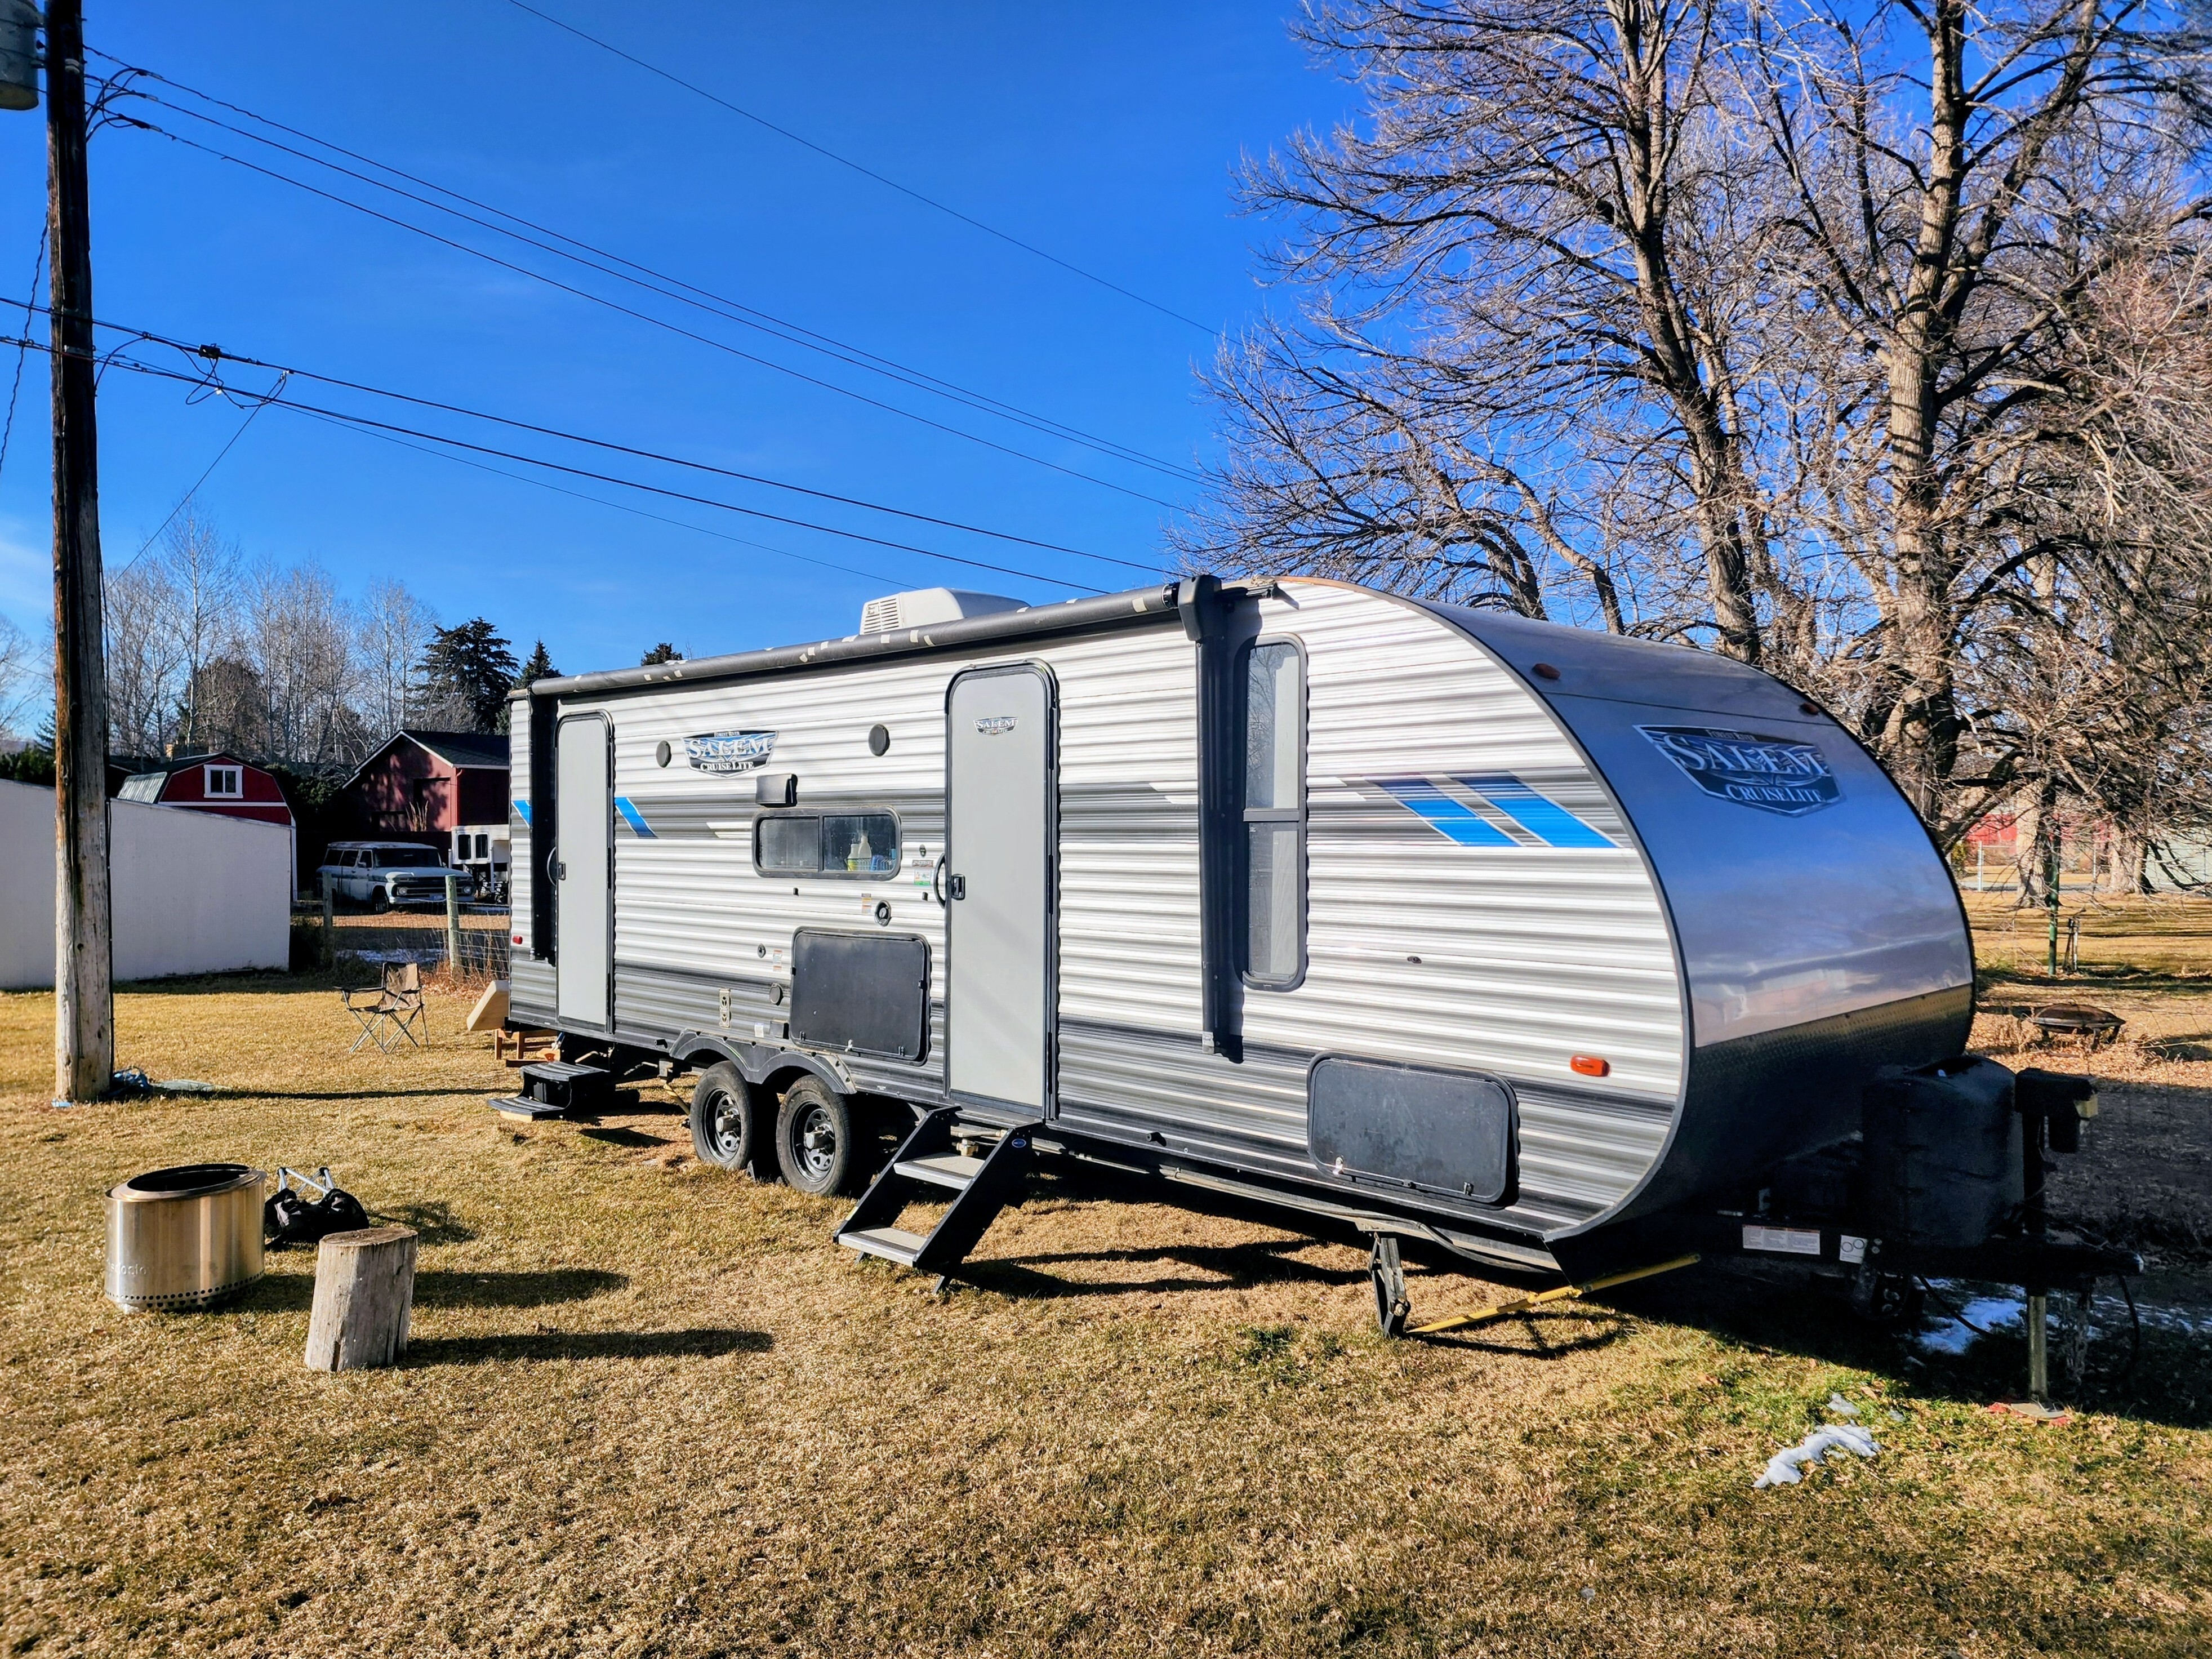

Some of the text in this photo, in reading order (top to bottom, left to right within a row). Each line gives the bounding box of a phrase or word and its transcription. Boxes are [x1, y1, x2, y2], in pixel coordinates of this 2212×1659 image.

[977, 719, 1015, 728] SALEM
[688, 737, 771, 758] SALEM
[1663, 735, 1831, 777] SALEM
